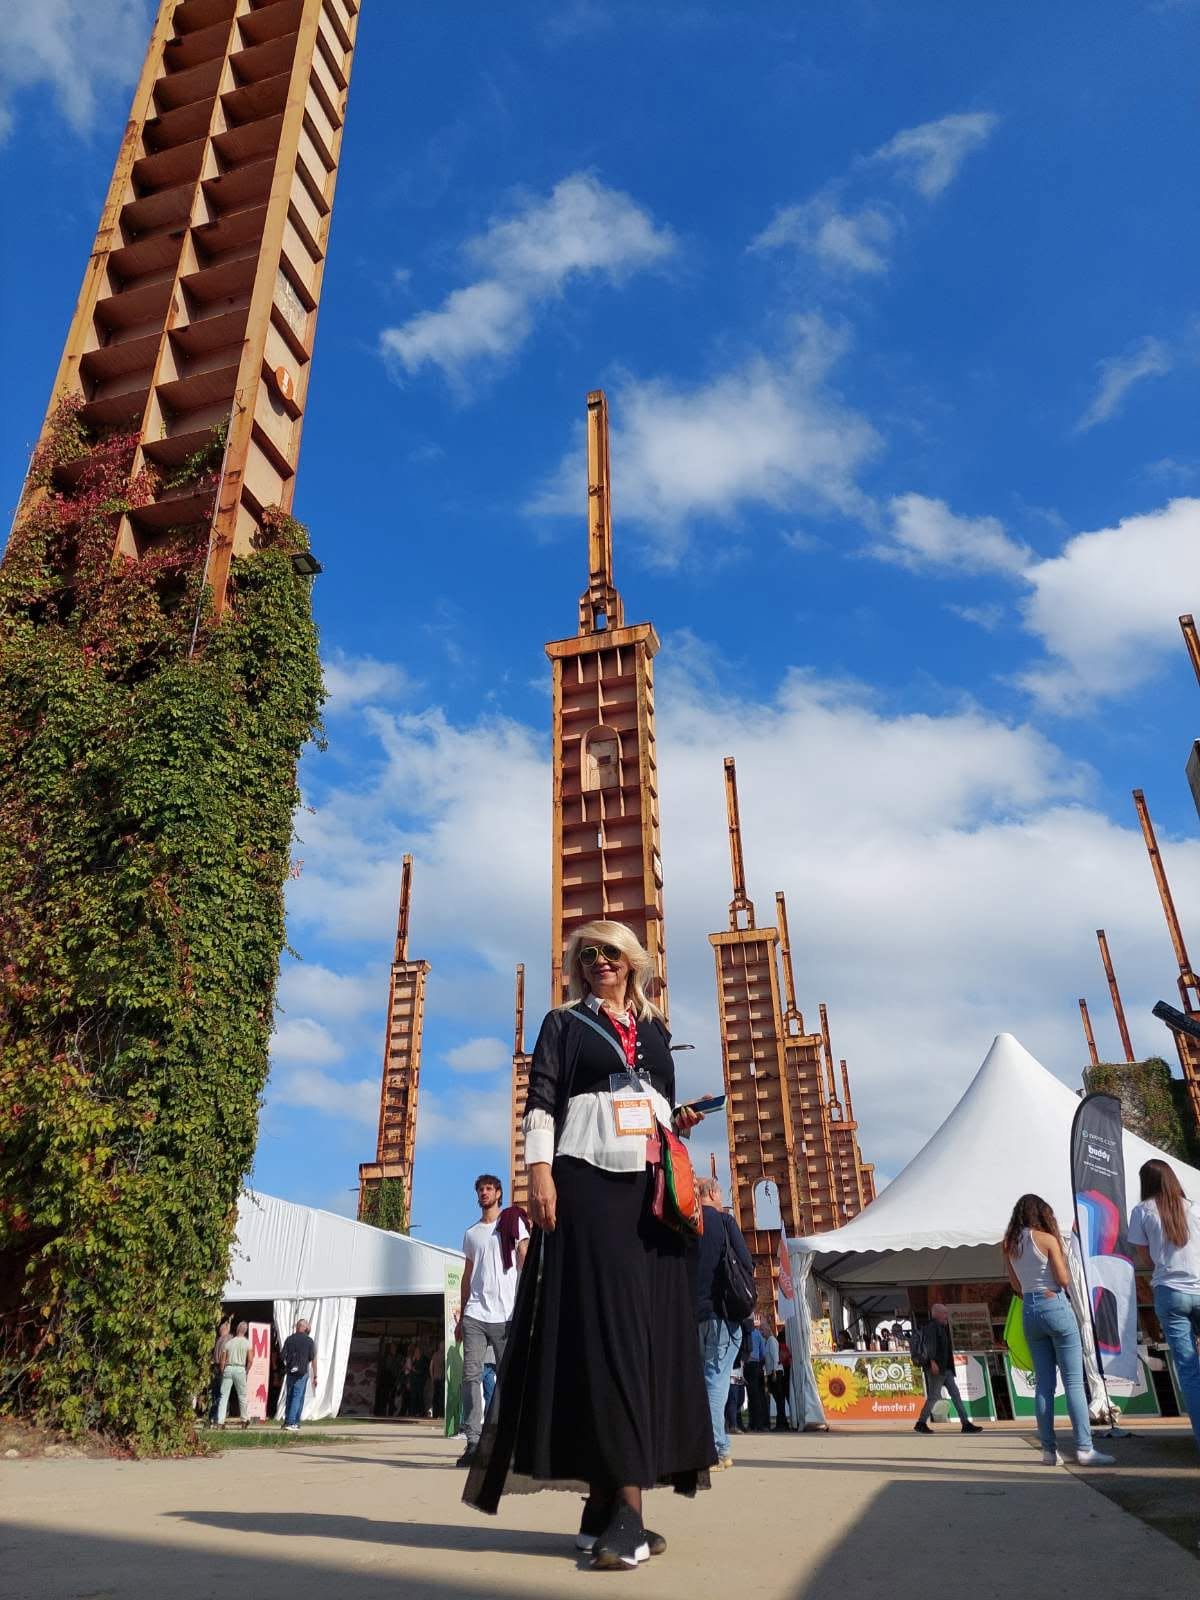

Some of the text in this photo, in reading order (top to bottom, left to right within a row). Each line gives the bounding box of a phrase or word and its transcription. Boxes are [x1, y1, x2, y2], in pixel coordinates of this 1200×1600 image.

[252, 1328, 268, 1358] M
[865, 1363, 904, 1382] 100
[869, 1382, 913, 1391] BIODINAMICA
[871, 1402, 915, 1412] demeter.it
